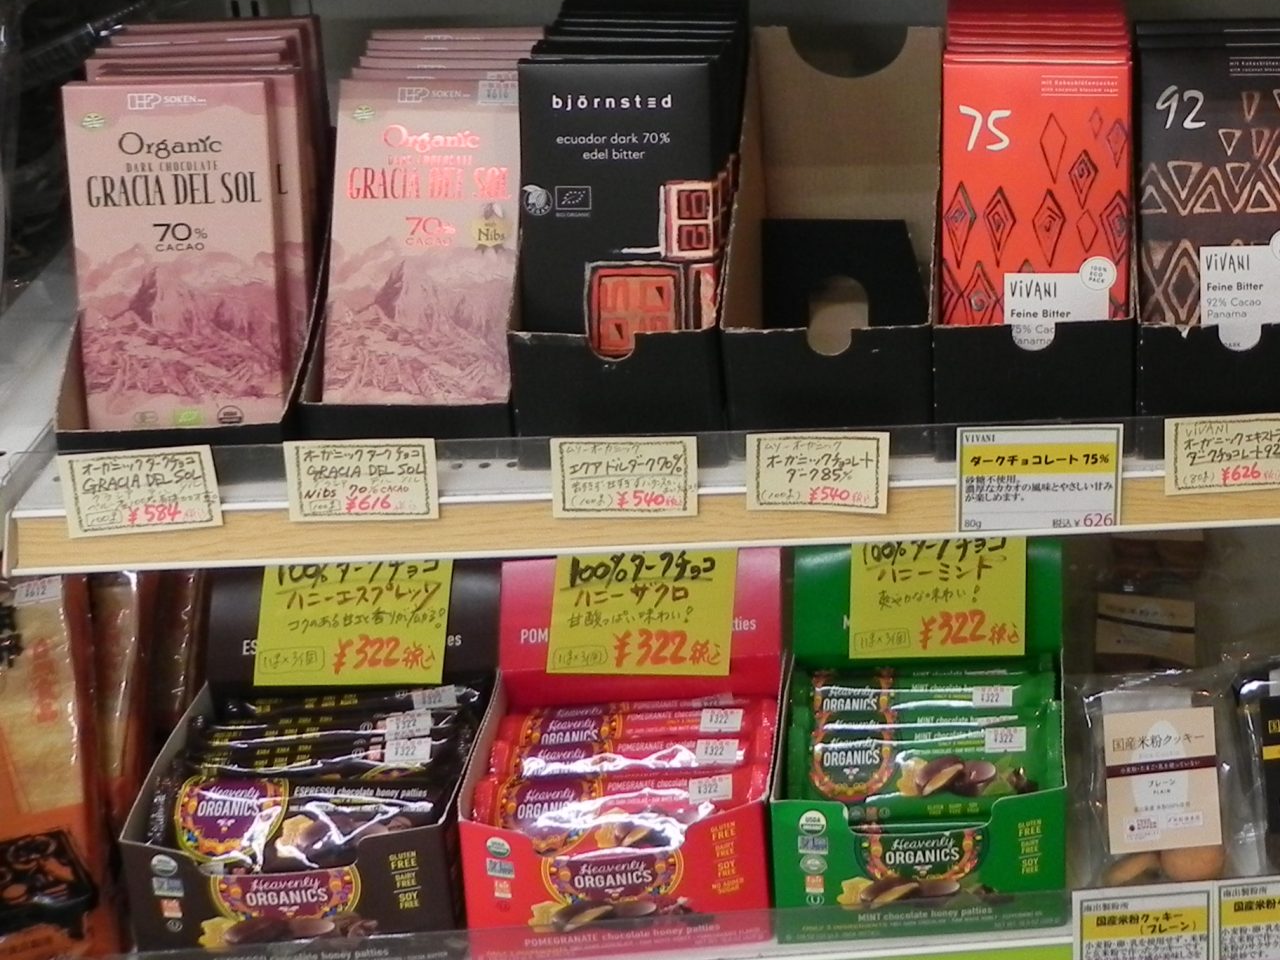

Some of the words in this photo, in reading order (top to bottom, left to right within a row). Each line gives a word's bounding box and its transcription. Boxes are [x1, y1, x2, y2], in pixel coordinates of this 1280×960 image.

[163, 95, 197, 105] SOKEN
[1155, 85, 1206, 130] 92
[959, 104, 1012, 152] 75
[118, 131, 223, 159] Organic
[383, 124, 480, 152] Organic
[556, 133, 607, 146] ecuador
[610, 132, 639, 145] dark
[642, 132, 670, 145] 70%
[582, 148, 609, 160] edel
[612, 148, 645, 160] bitter
[126, 162, 154, 172] DARK
[158, 161, 219, 172] CHOCOLATE
[87, 175, 164, 208] GRACIA
[174, 172, 216, 206] DEL
[221, 170, 262, 204] SOL
[155, 243, 205, 252] CACAO
[1207, 282, 1232, 292] Feine
[1235, 282, 1264, 292] Bitter
[1206, 298, 1228, 307] 92%
[1231, 297, 1262, 307] Cacao
[1010, 308, 1038, 319] Feine
[1041, 308, 1071, 319] Bitter
[1207, 310, 1248, 319] Panama
[964, 433, 996, 443] VIVANI
[969, 453, 1079, 467] ダークチョコレート
[1083, 452, 1110, 465] 75%
[345, 495, 392, 513] ¥616
[127, 507, 182, 525] ¥584
[1083, 513, 1114, 528] 626
[877, 560, 994, 582] ハニーミント
[574, 582, 690, 606] ハニーザクロ
[613, 629, 687, 667] ¥322
[1112, 731, 1205, 752] 国産米粉クッキー
[823, 749, 880, 765] ORGANICS
[375, 786, 398, 799] honey
[400, 786, 427, 799] patties
[607, 780, 655, 791] POMEGRANATE
[657, 778, 688, 788] chocolate
[523, 788, 575, 802] Heavenly
[891, 837, 956, 851] Heavenly
[885, 847, 960, 864] ORGANICS
[580, 859, 646, 874] Heavenly
[251, 876, 322, 892] Heavenly
[574, 870, 652, 889] ORGANICS
[246, 888, 329, 906] ORGANICS
[858, 913, 882, 922] MINT
[884, 910, 928, 920] chocolate
[931, 908, 959, 919] honey
[961, 906, 992, 917] patties
[1095, 911, 1184, 927] 国産米粉クッキー
